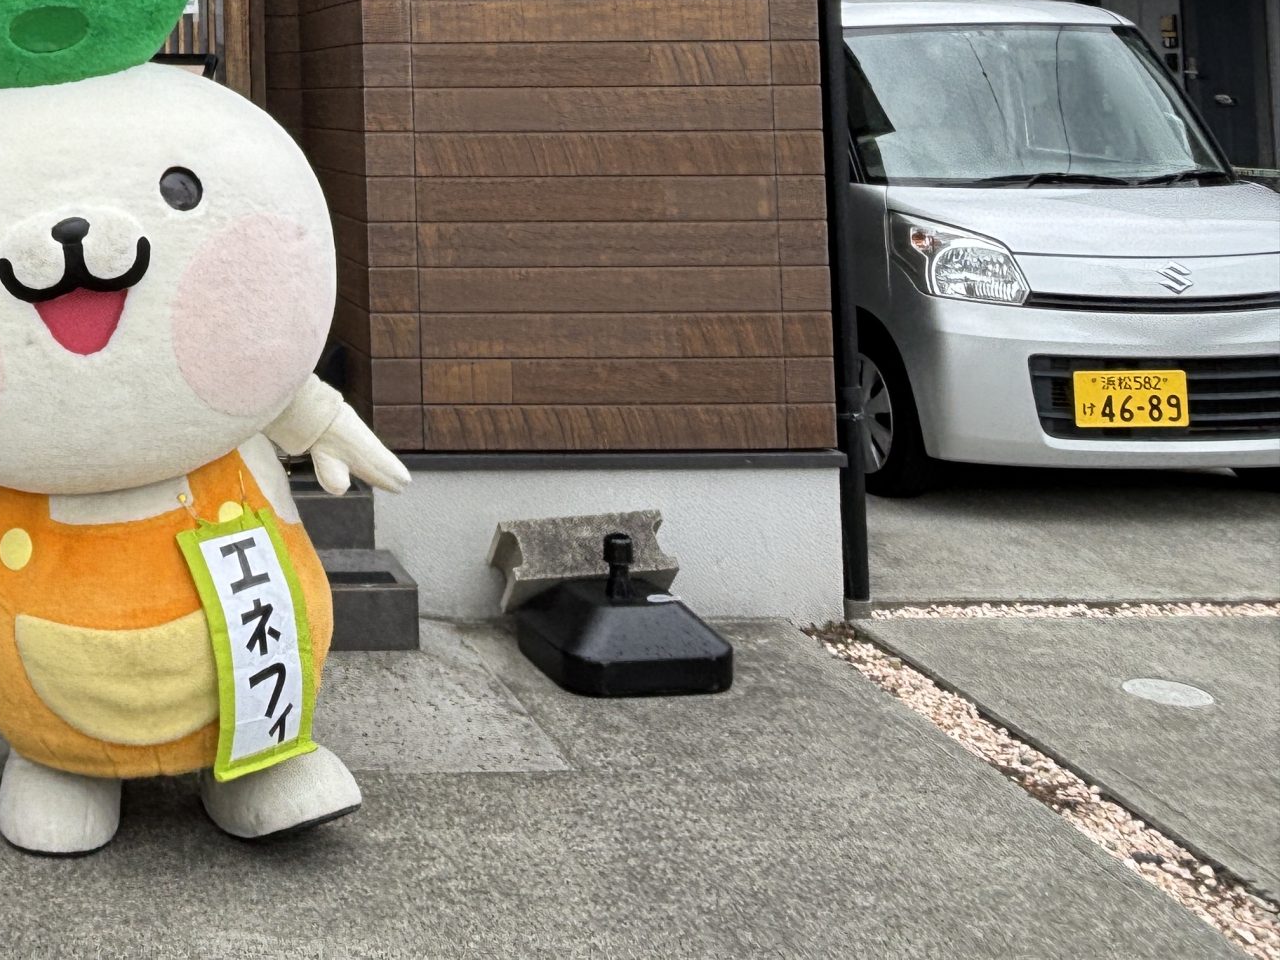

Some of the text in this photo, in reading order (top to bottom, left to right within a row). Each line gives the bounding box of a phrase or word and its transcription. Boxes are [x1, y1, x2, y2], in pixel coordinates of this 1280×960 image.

[1082, 394, 1183, 423] け 46-89
[219, 536, 294, 743] エネフィ
